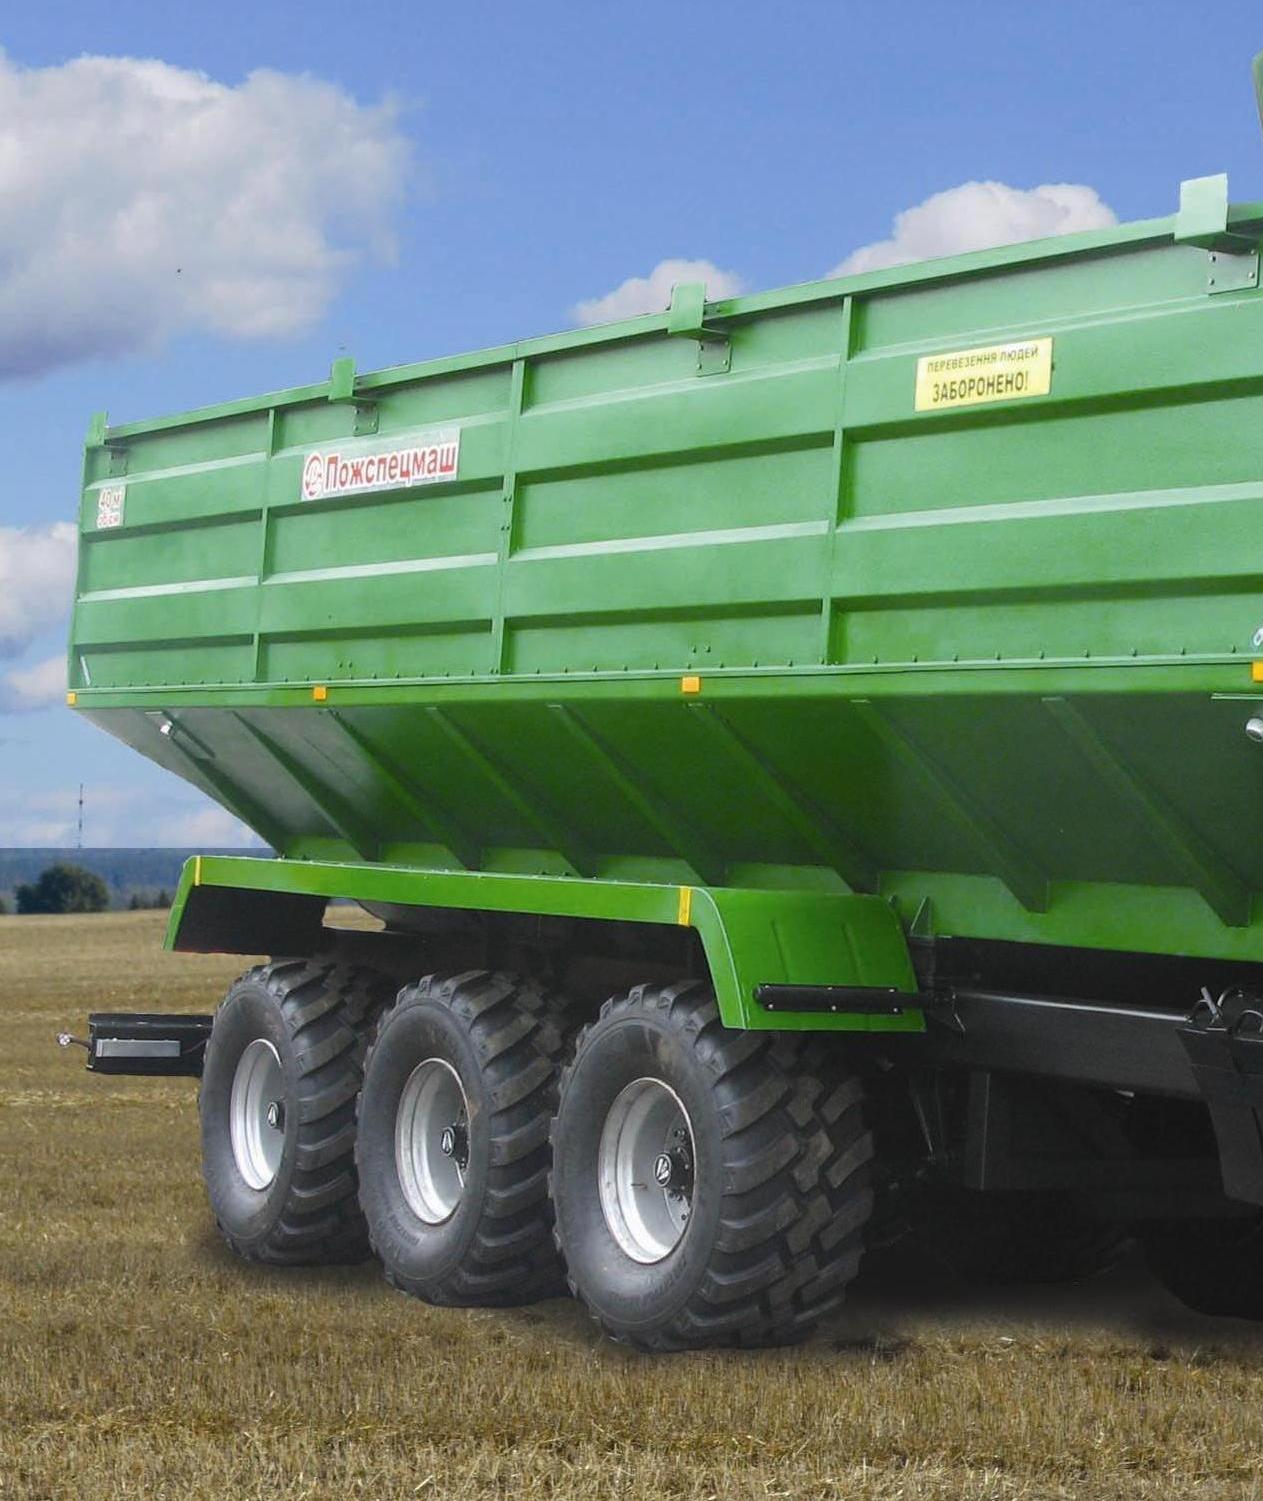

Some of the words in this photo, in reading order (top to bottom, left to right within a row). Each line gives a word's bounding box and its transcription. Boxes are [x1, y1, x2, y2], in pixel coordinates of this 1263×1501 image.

[927, 352, 998, 373] ПЕРЕВЕЗЕННЯ
[1000, 346, 1039, 363] ЛЮДЕЙ
[932, 371, 1029, 403] ЗАБОРОНЕНО!
[325, 446, 456, 490] Пожспецмаш
